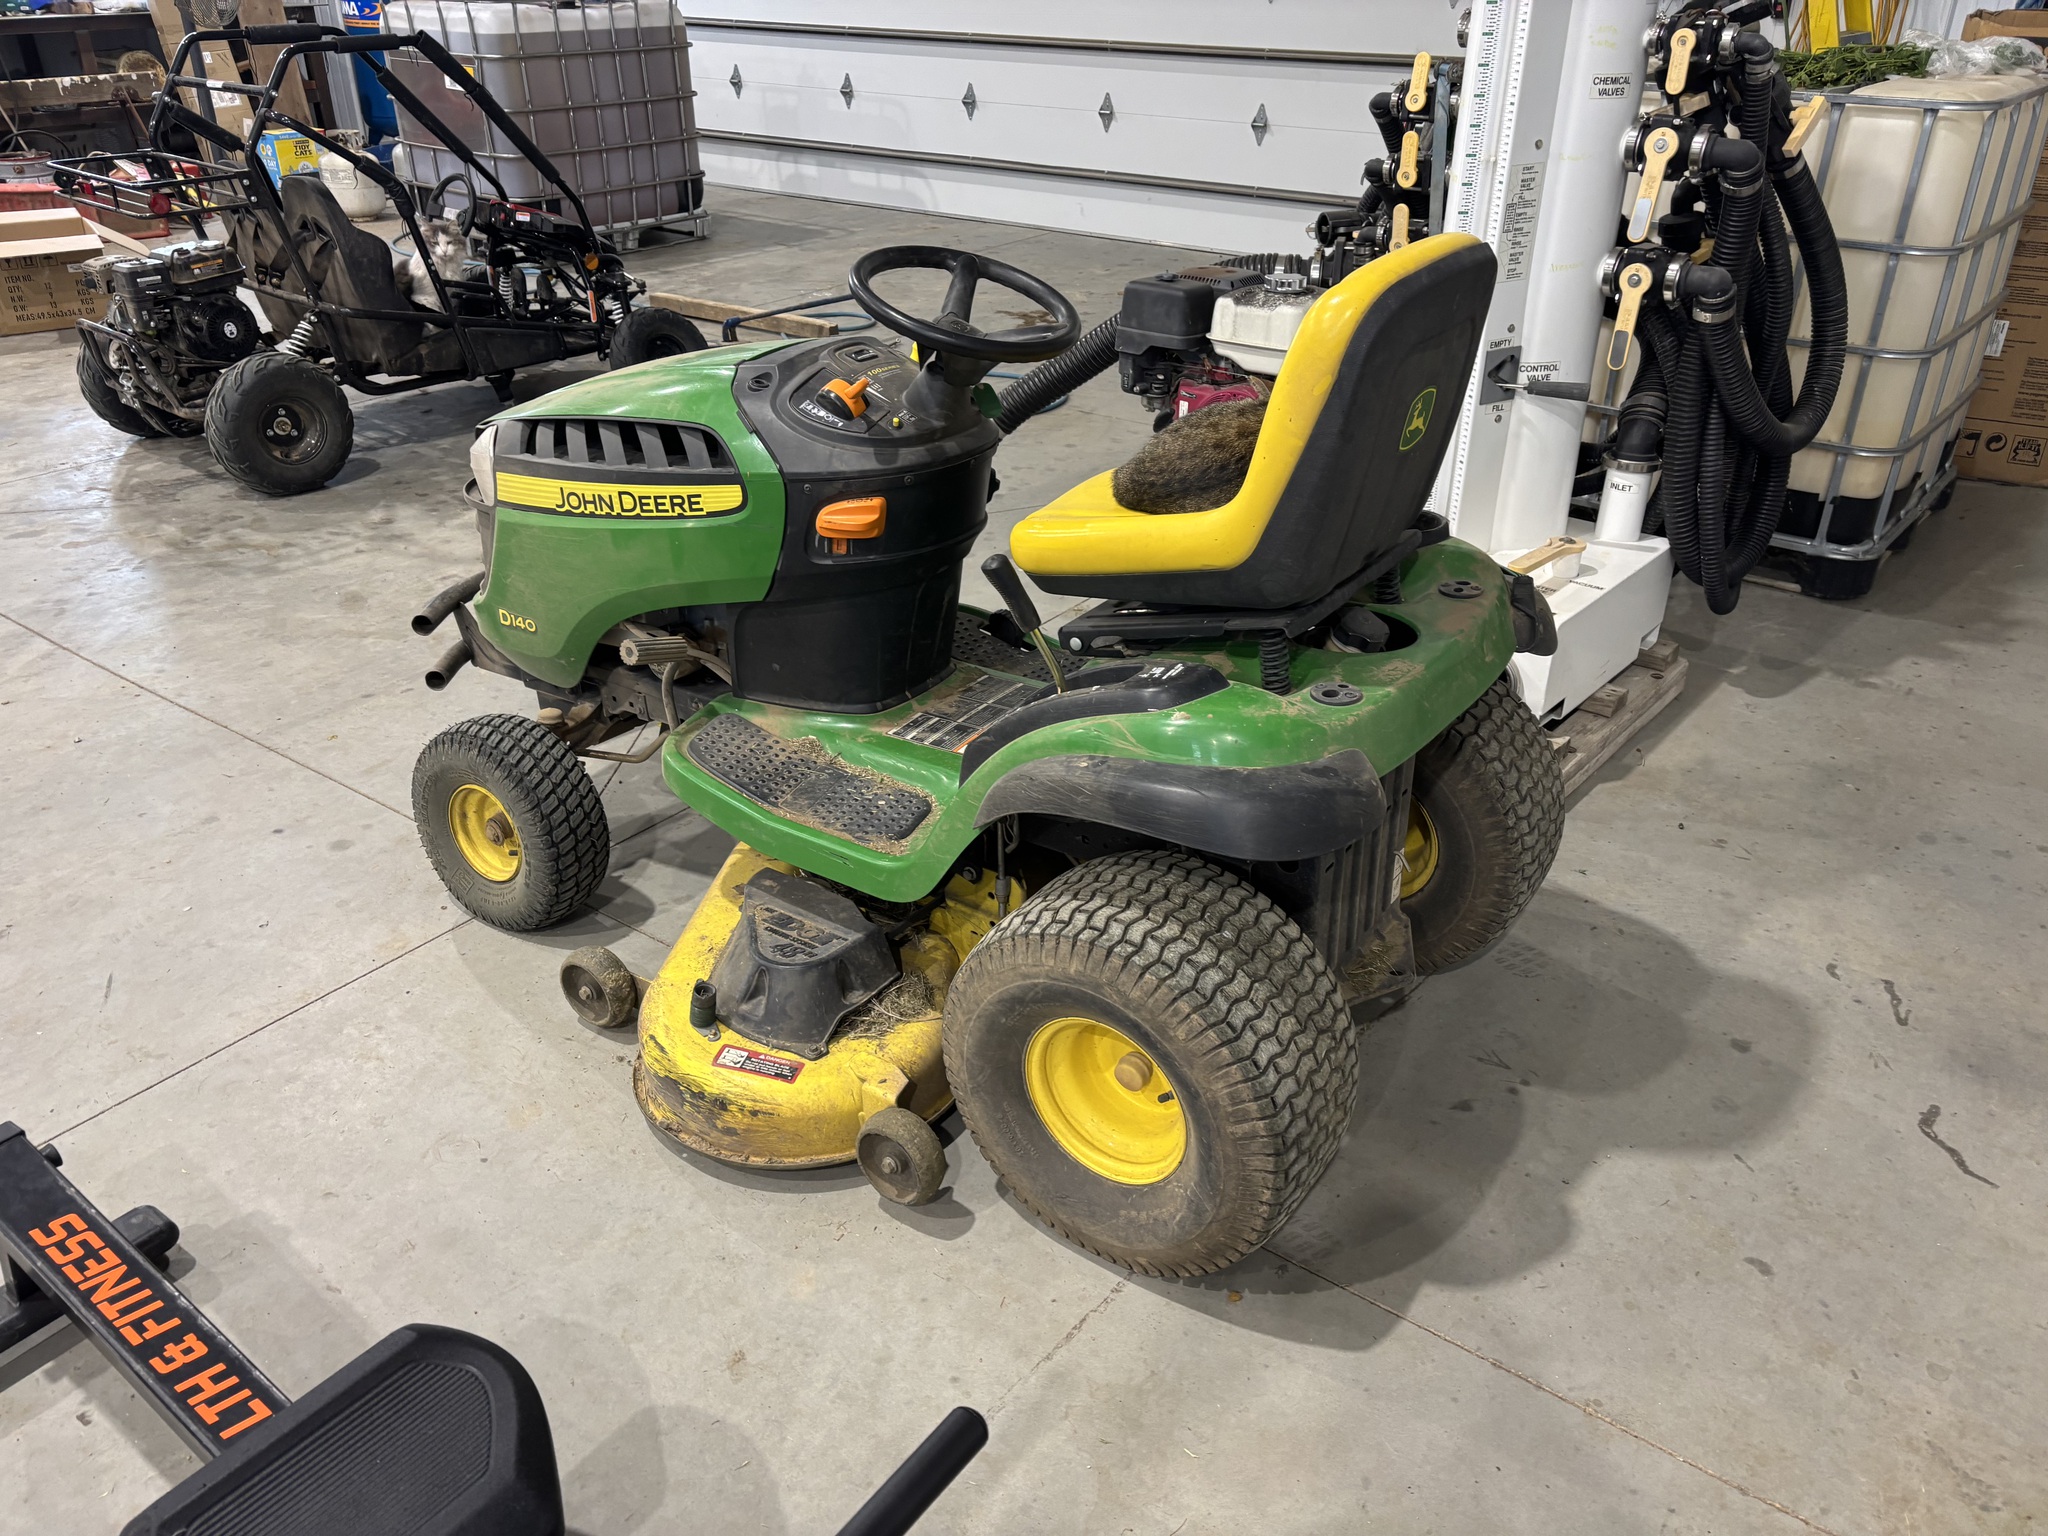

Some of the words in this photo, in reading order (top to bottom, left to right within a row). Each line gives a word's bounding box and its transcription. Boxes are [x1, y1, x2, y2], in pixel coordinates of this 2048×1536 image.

[1593, 76, 1631, 86] CHEMICAL
[1598, 87, 1625, 97] VALVES
[4, 276, 21, 284] ITEM
[22, 274, 34, 282] NO.
[44, 282, 52, 290] 12
[76, 288, 91, 297] KGS
[50, 301, 58, 309] 13
[80, 297, 95, 306] KGS
[85, 307, 96, 315] CM
[1489, 338, 1512, 349] EMPTY
[867, 367, 882, 376] 100
[1519, 363, 1560, 373] CONTROL
[1526, 373, 1552, 382] VALVE
[1491, 404, 1505, 412] FILL
[1609, 482, 1634, 493] INLET
[555, 487, 616, 513] JOHN
[618, 490, 705, 514] DEERE
[498, 608, 537, 633] D140
[765, 1055, 791, 1065] DANGER
[28, 1213, 182, 1347] FITNESS
[148, 1333, 209, 1375] &
